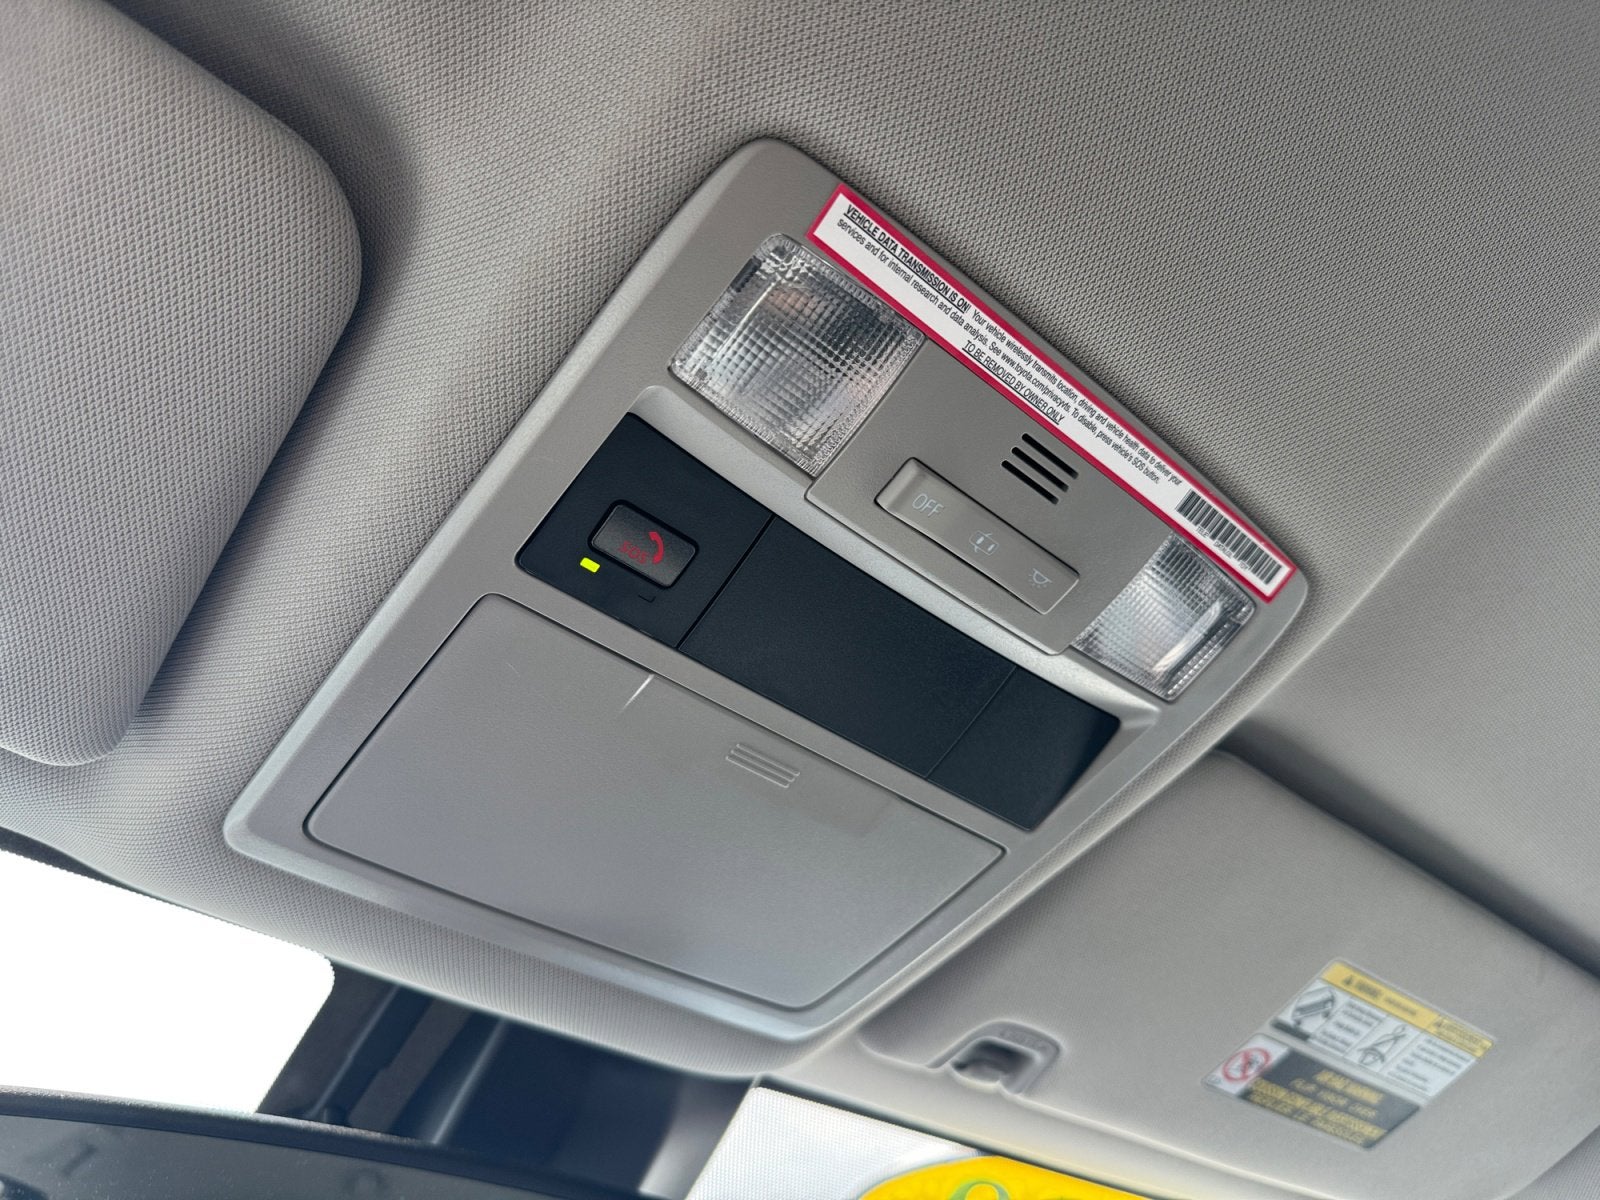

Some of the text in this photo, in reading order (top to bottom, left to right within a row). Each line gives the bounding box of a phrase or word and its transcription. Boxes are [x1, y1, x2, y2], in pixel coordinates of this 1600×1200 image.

[836, 215, 1162, 485] services and for internal research and data analysis. See www.toyota.com/privacyvts. To disable, press vehicle's SOS button.
[844, 203, 1182, 488] VEHICLE DATA TRANSMISSION IS ON! Your vehicle wirelessly transmits location, driving and vehicle health data to deliver your
[963, 338, 1065, 424] TO BE REMOVED BY OWNER ONLY
[911, 493, 944, 517] OFF
[618, 541, 651, 565] SOS
